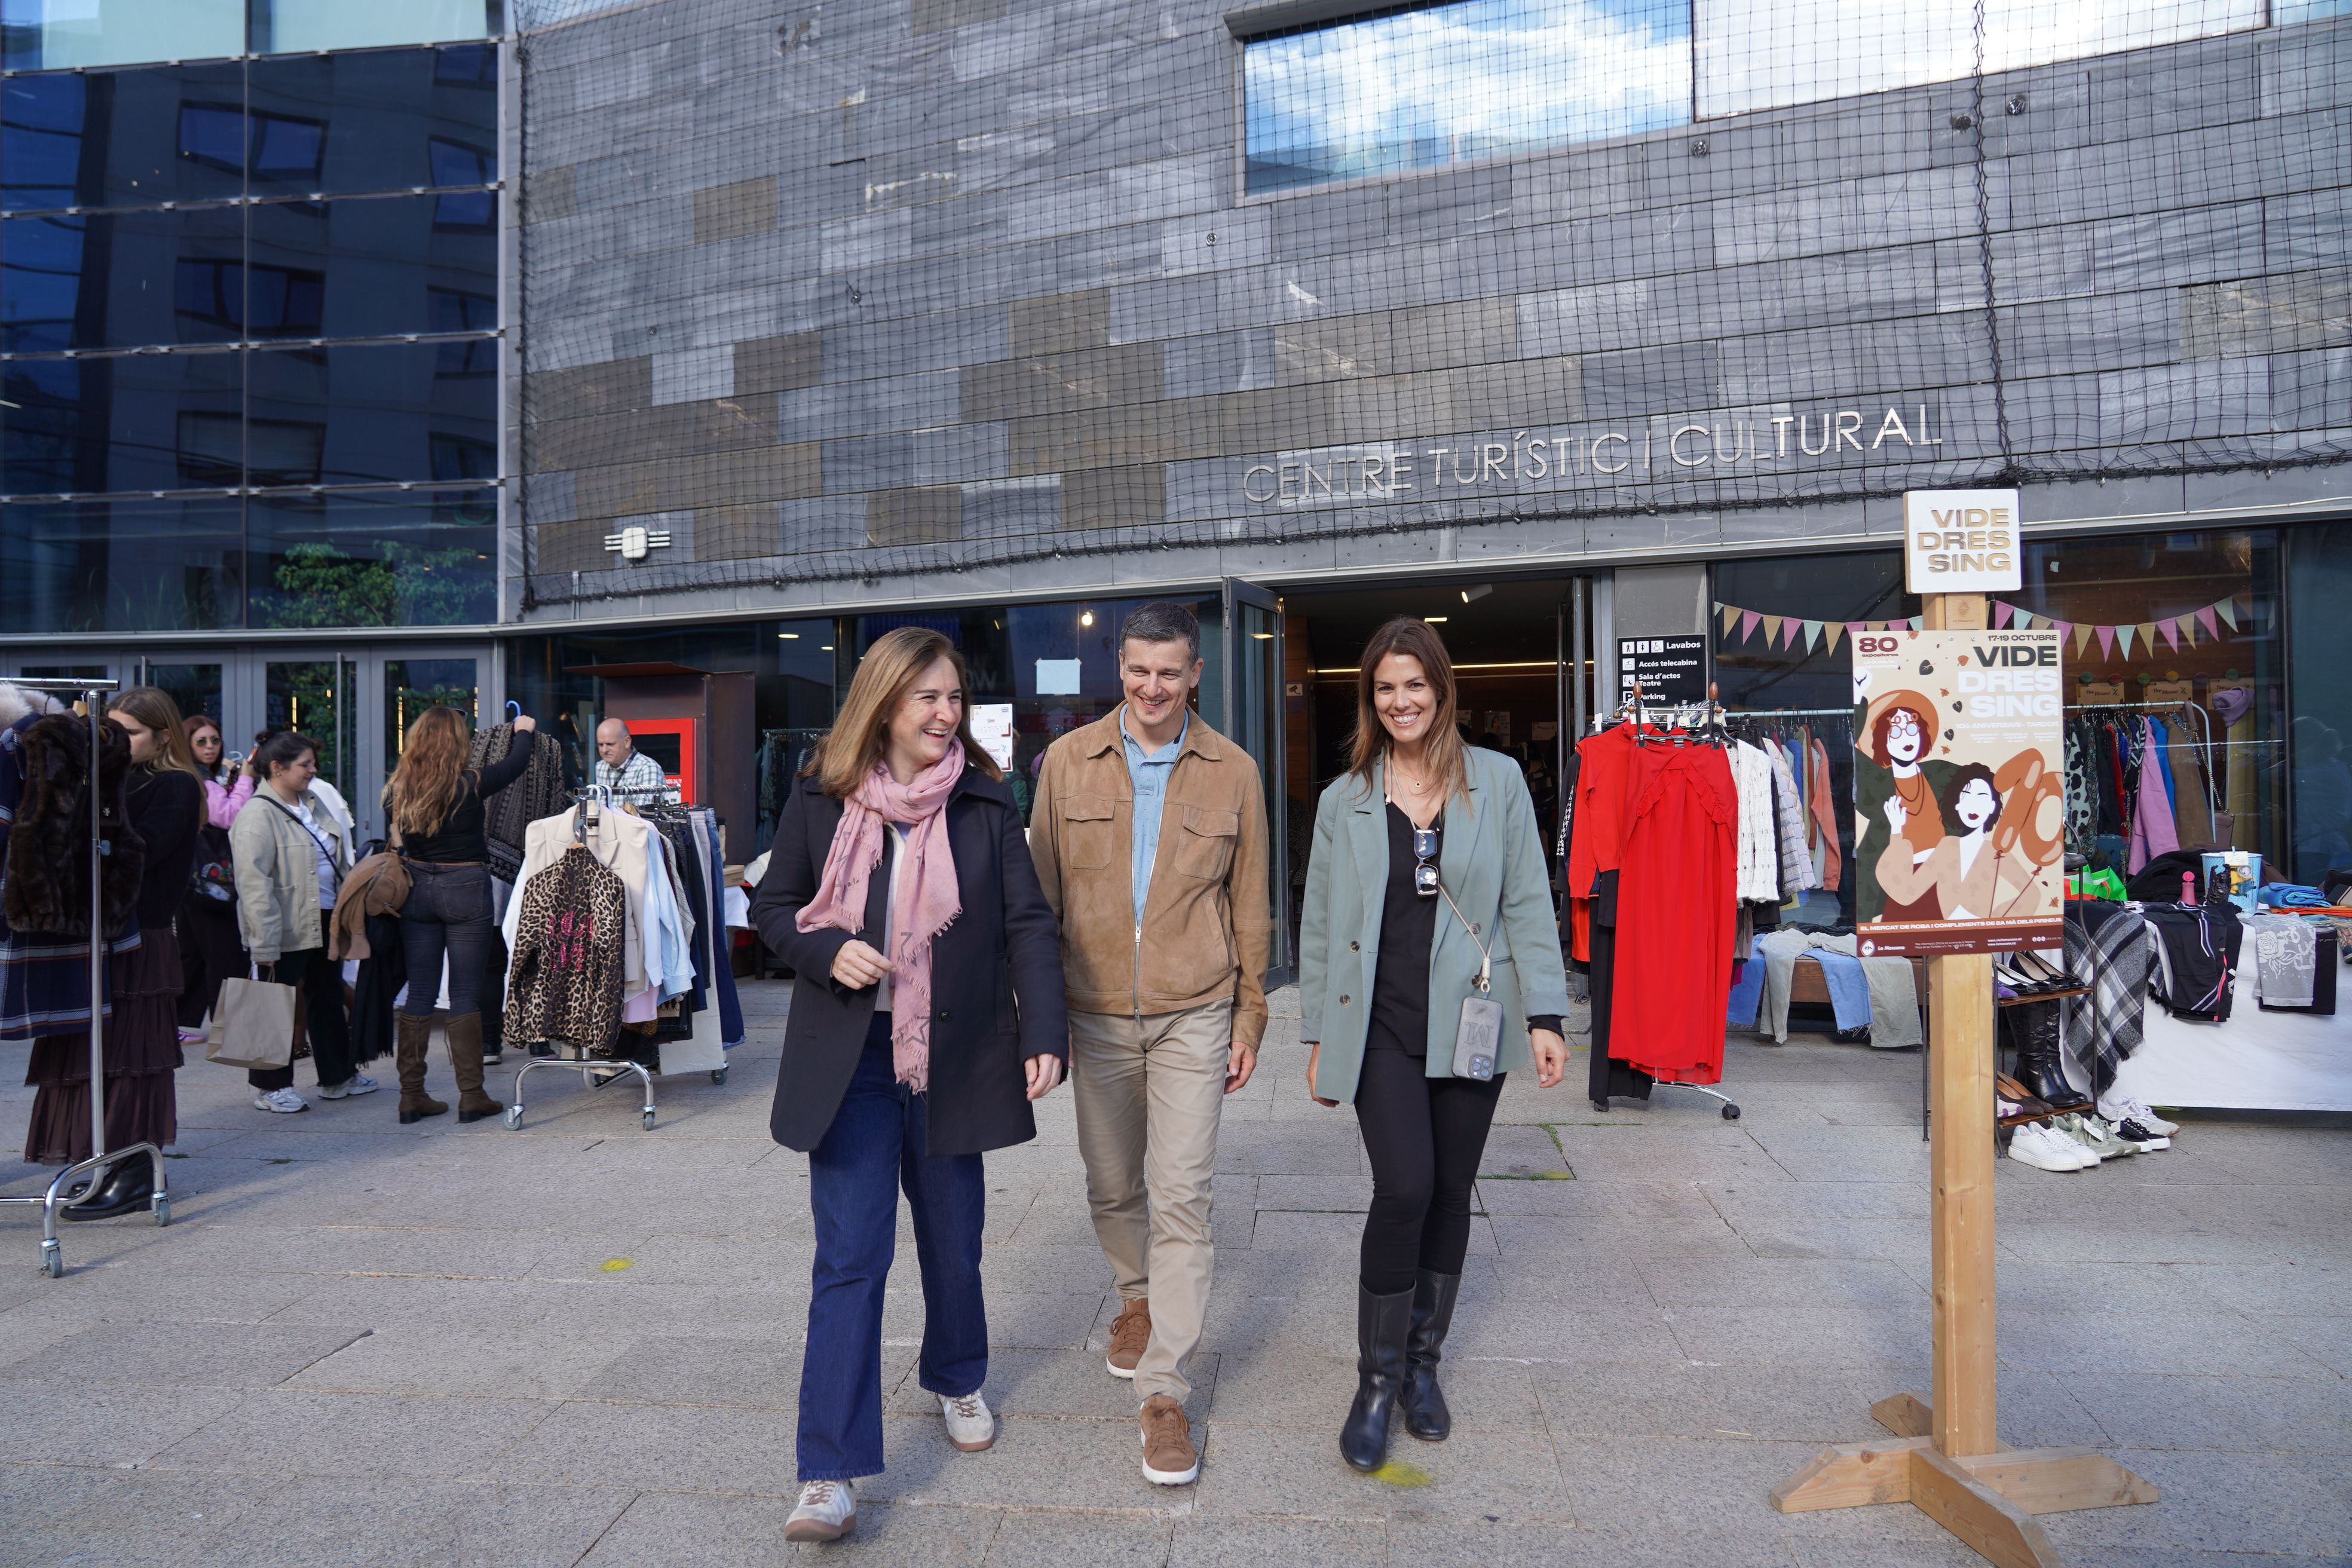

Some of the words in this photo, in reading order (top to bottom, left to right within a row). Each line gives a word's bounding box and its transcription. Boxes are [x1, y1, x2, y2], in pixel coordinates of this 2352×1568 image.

[1243, 451, 1412, 503] CENTRE
[1428, 431, 1628, 486] TURÍSTIC
[1644, 430, 1651, 469] I
[1670, 404, 1943, 467] CULTURAL
[1931, 508, 2010, 528] VIDE
[1918, 530, 2011, 551] DRES
[1928, 553, 2011, 573] SING
[1666, 641, 1701, 650] Lavabos
[1858, 637, 1898, 653] 80
[1973, 645, 2057, 667] VIDE
[1958, 669, 2059, 693] DRES
[1970, 694, 2059, 718] SING
